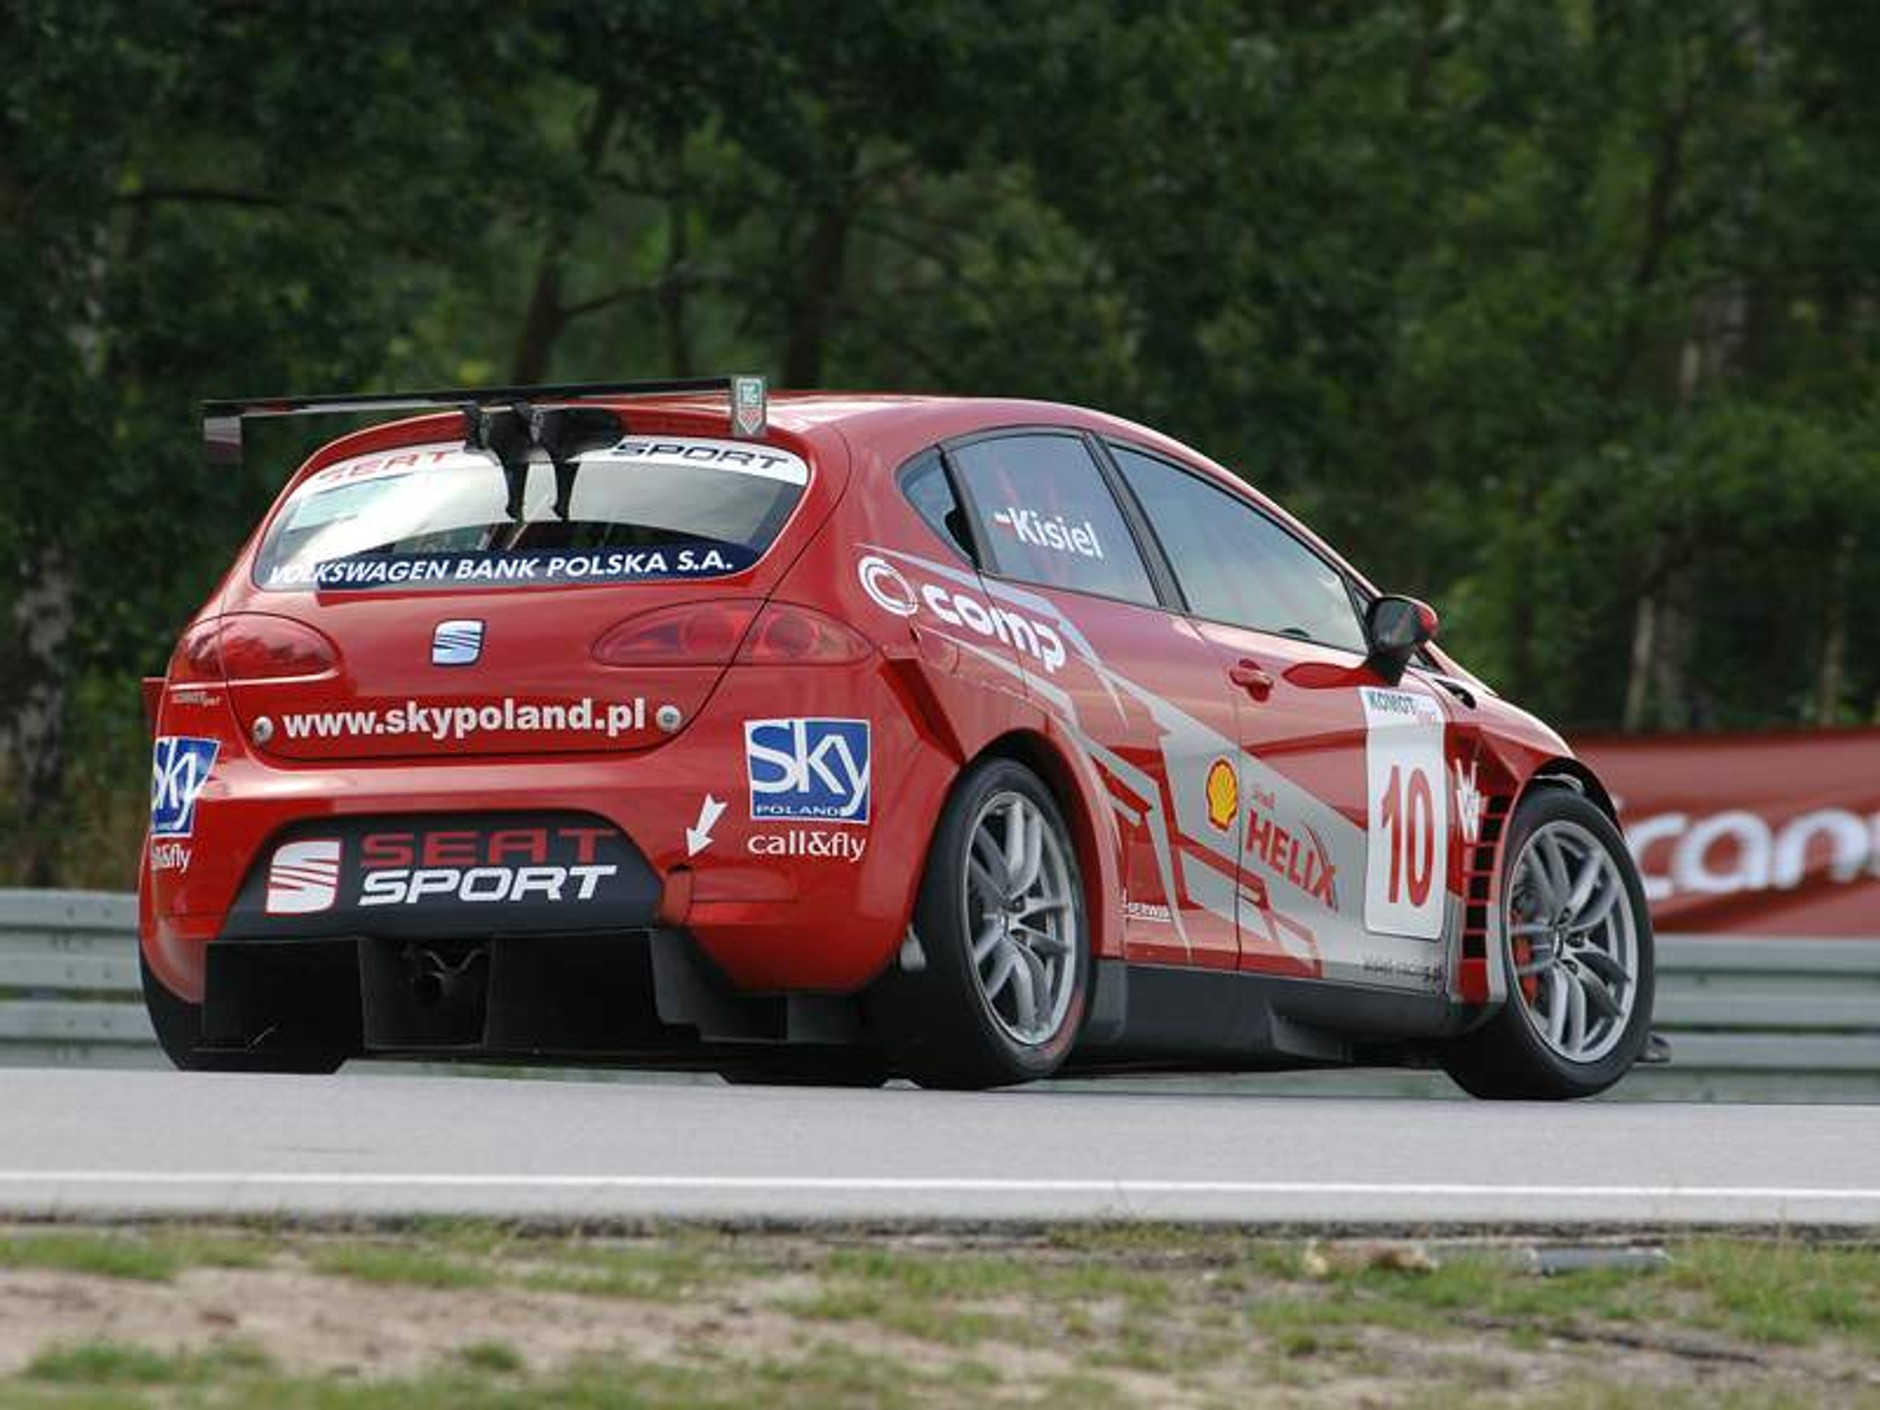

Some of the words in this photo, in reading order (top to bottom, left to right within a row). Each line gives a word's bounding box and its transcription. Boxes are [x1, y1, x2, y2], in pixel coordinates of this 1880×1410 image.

[318, 451, 460, 484] SEAT
[608, 441, 789, 470] SPORT
[1009, 507, 1104, 560] Kisiel
[269, 560, 448, 585] VOLKSWAGEN
[455, 558, 540, 580] BANK
[546, 554, 668, 577] POLSKA
[677, 550, 733, 571] S.A.
[921, 584, 1066, 673] comp
[283, 698, 646, 739] www.skypoland.pl
[756, 803, 839, 816] POLAND
[359, 827, 621, 868] SEAT
[748, 830, 866, 864] call&fly
[1382, 765, 1435, 907] 10
[1246, 808, 1335, 910] HELIX
[357, 865, 617, 906] SPORT
